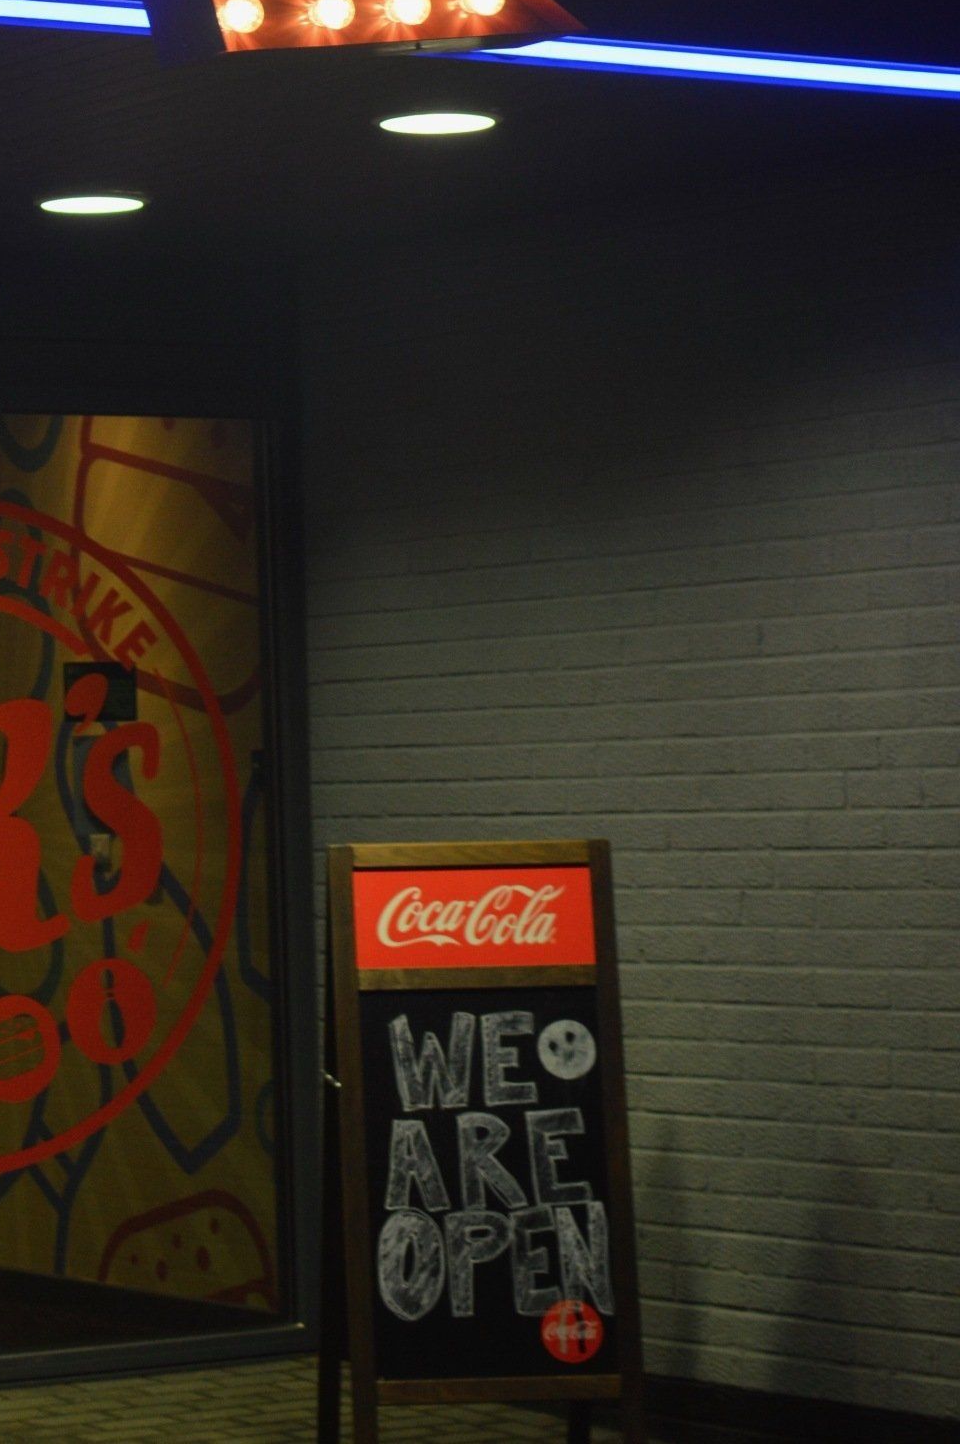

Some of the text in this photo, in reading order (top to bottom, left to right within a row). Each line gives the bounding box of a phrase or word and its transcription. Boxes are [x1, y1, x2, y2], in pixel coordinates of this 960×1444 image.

[376, 884, 568, 948] Coca-Cola
[388, 1010, 539, 1112] WE
[383, 1107, 594, 1213] ARE
[376, 1200, 615, 1322] OPEN
